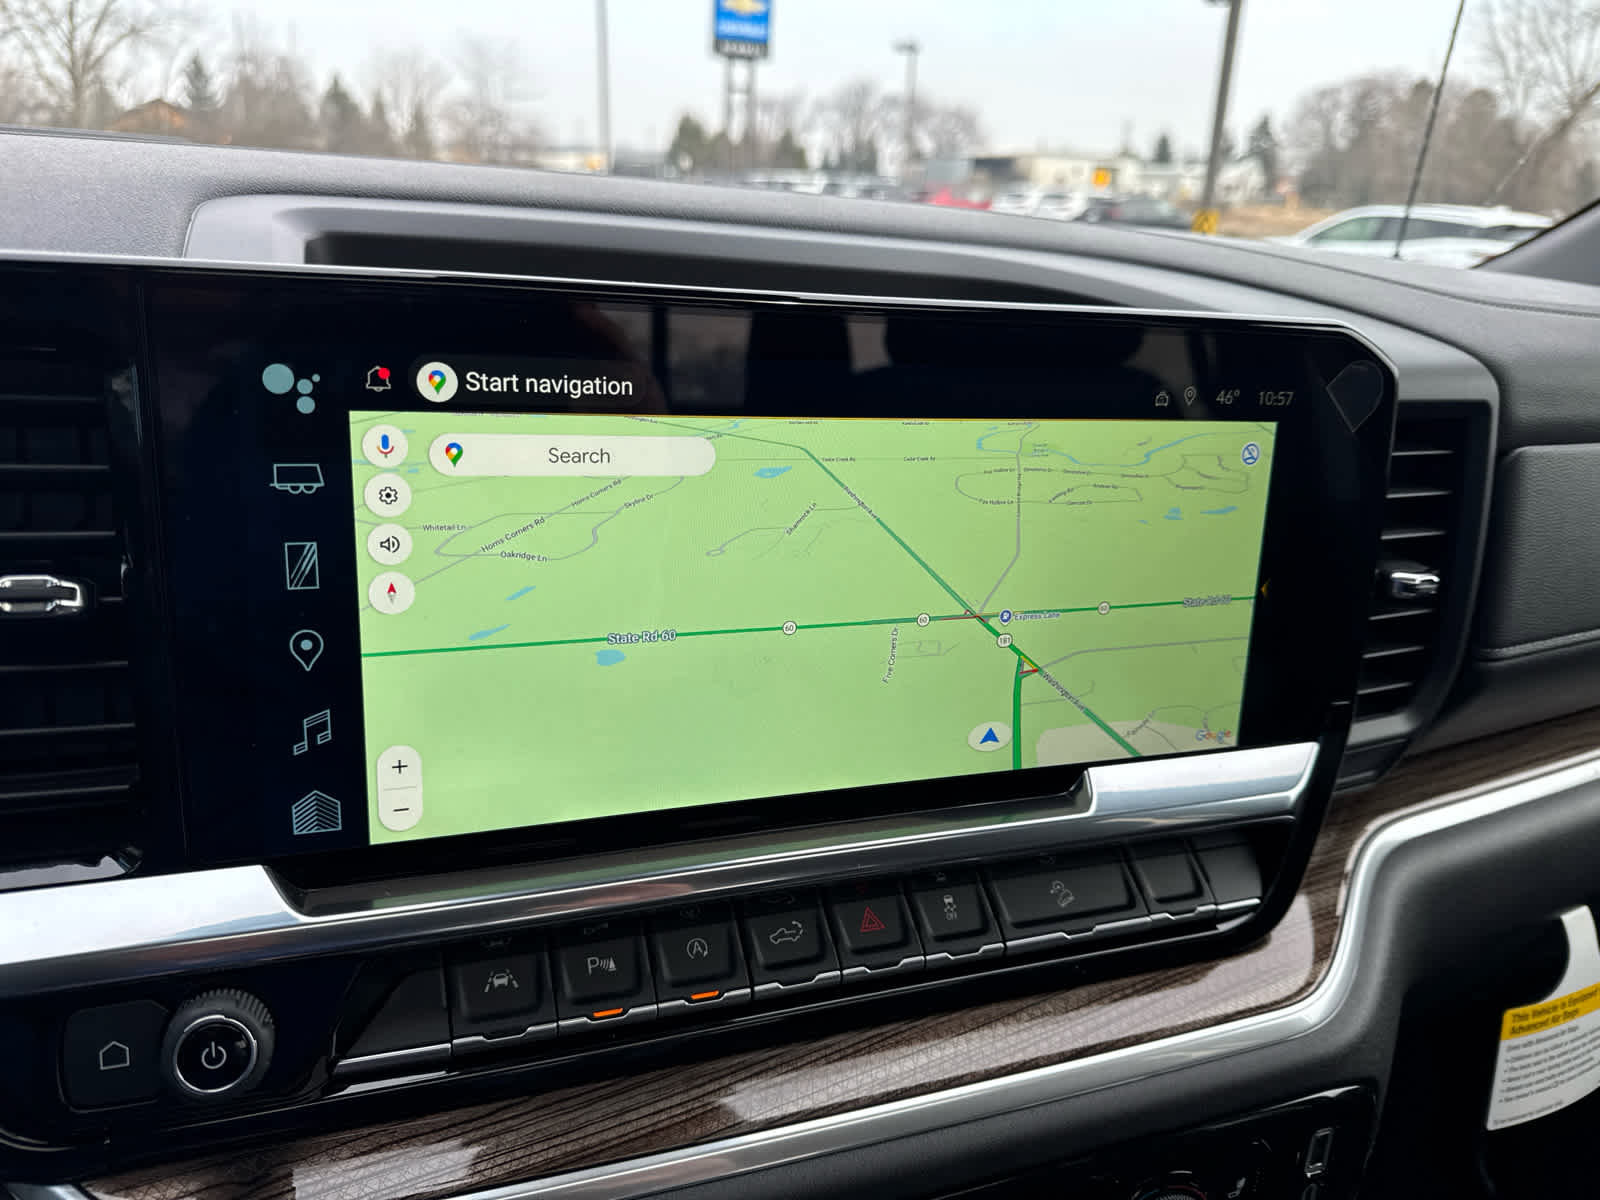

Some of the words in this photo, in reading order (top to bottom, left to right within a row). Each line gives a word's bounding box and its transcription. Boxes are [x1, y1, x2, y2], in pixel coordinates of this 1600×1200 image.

[465, 371, 519, 392] Start
[526, 375, 633, 398] navigation
[1258, 391, 1294, 406] 10:57
[548, 447, 611, 464] Search
[571, 494, 590, 507] Horns
[590, 485, 612, 500] Corners
[624, 496, 646, 509] Skyline
[422, 523, 456, 532] Whitetail
[456, 523, 466, 531] Ln
[480, 537, 505, 553] Horns
[504, 521, 534, 541] Corners
[534, 516, 546, 527] Rd
[499, 550, 536, 561] Oakridge
[537, 554, 548, 563] Ln
[785, 624, 794, 632] 60
[607, 632, 640, 645] State
[641, 631, 658, 642] Rd
[661, 629, 677, 641] 60
[1195, 729, 1232, 744] Googe
